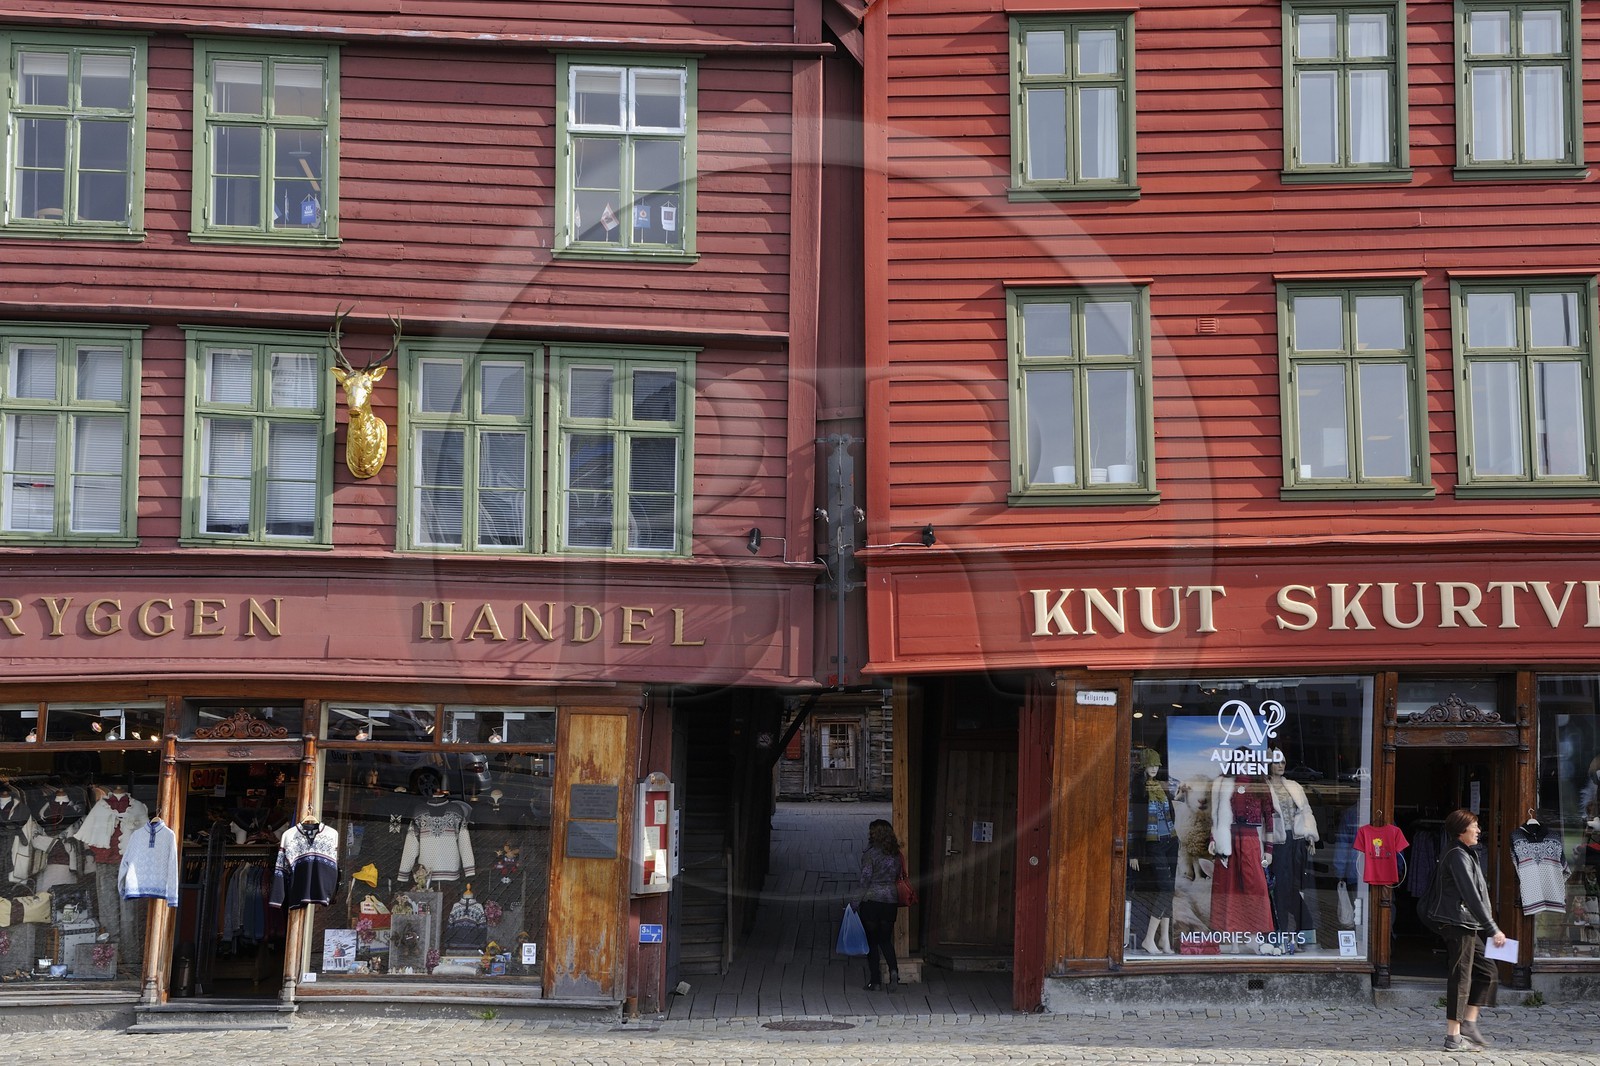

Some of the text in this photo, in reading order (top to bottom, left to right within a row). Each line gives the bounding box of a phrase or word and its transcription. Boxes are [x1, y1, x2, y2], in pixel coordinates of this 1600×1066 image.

[1031, 586, 1227, 637] KNUT
[420, 601, 706, 647] HANDEL
[1210, 749, 1284, 762] AUDHILD
[1219, 763, 1269, 775] VIKEN
[1180, 931, 1306, 945] MEMORIES & GIFTS
